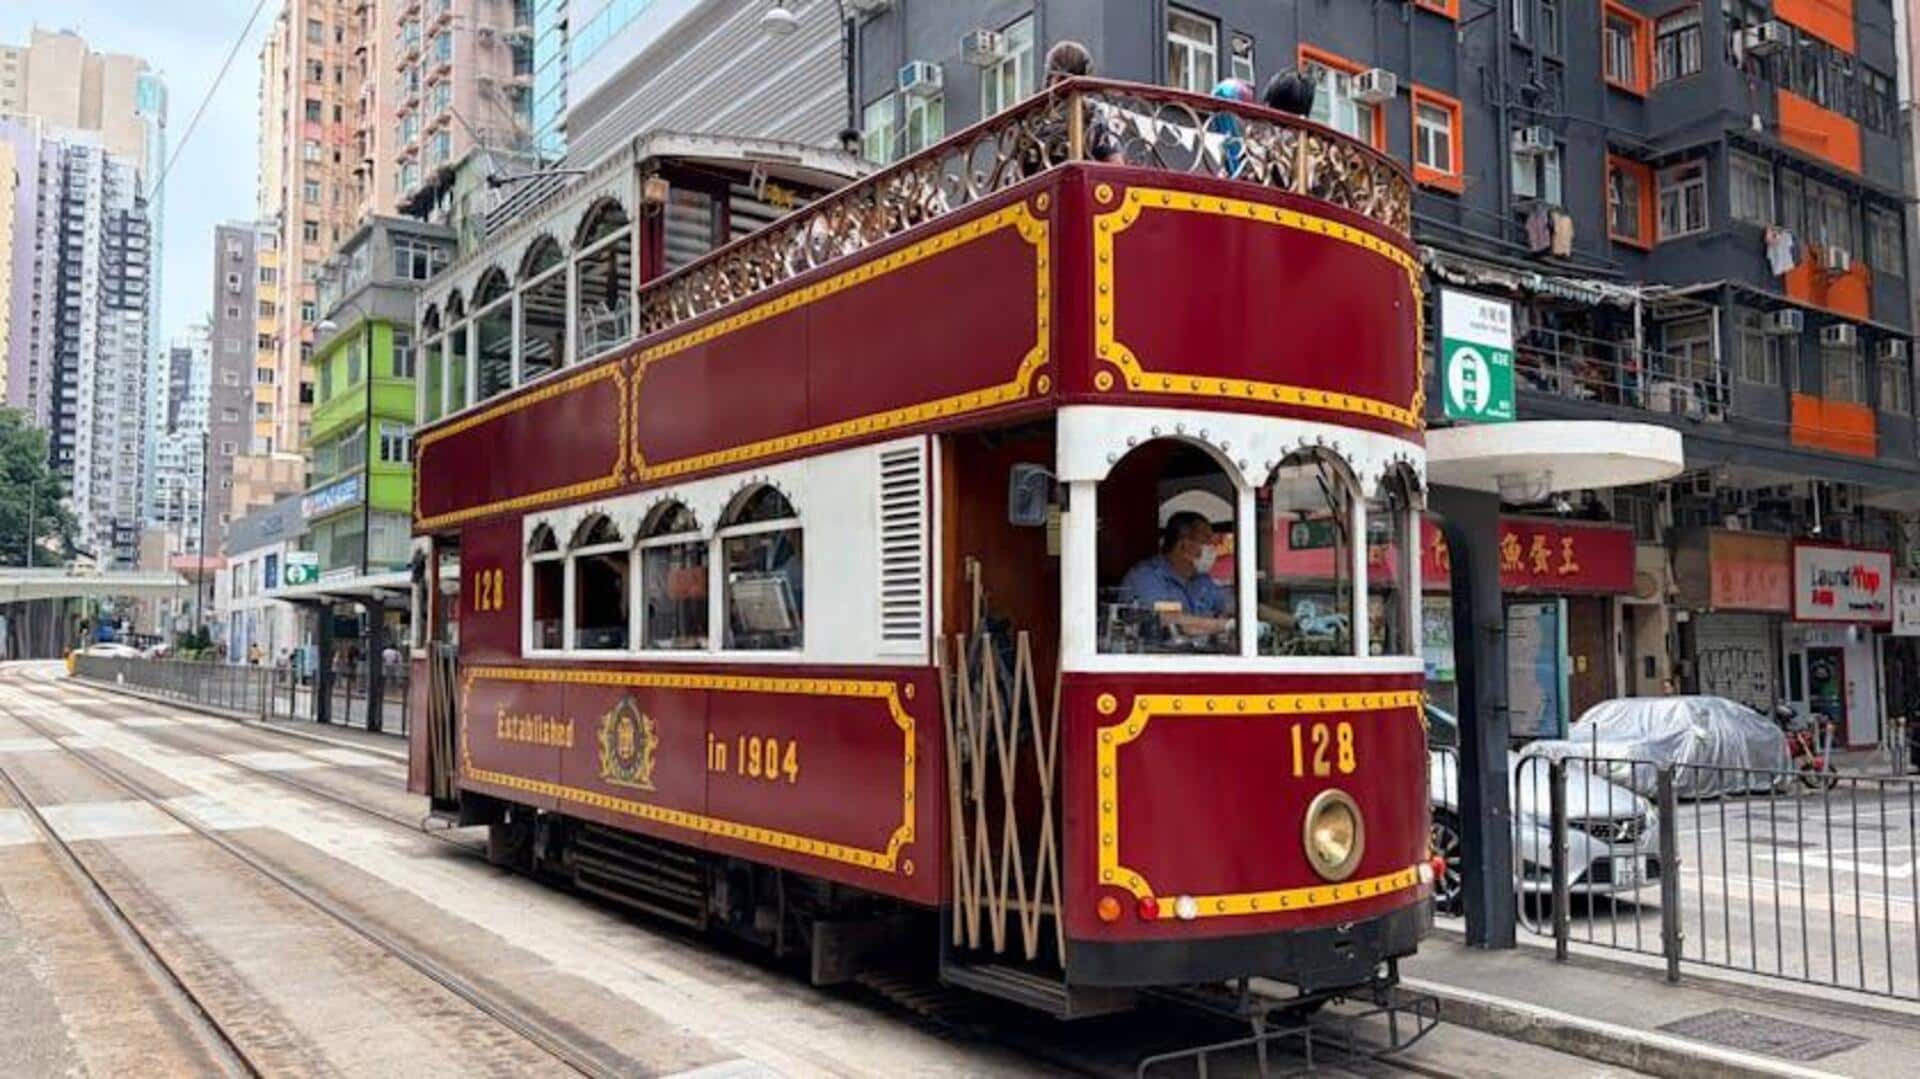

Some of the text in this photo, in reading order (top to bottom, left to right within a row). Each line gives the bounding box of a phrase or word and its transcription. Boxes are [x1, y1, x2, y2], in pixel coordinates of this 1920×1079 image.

[474, 568, 504, 612] 128
[497, 710, 575, 748] Established
[1290, 720, 1357, 777] 128
[708, 732, 799, 784] in 1904
